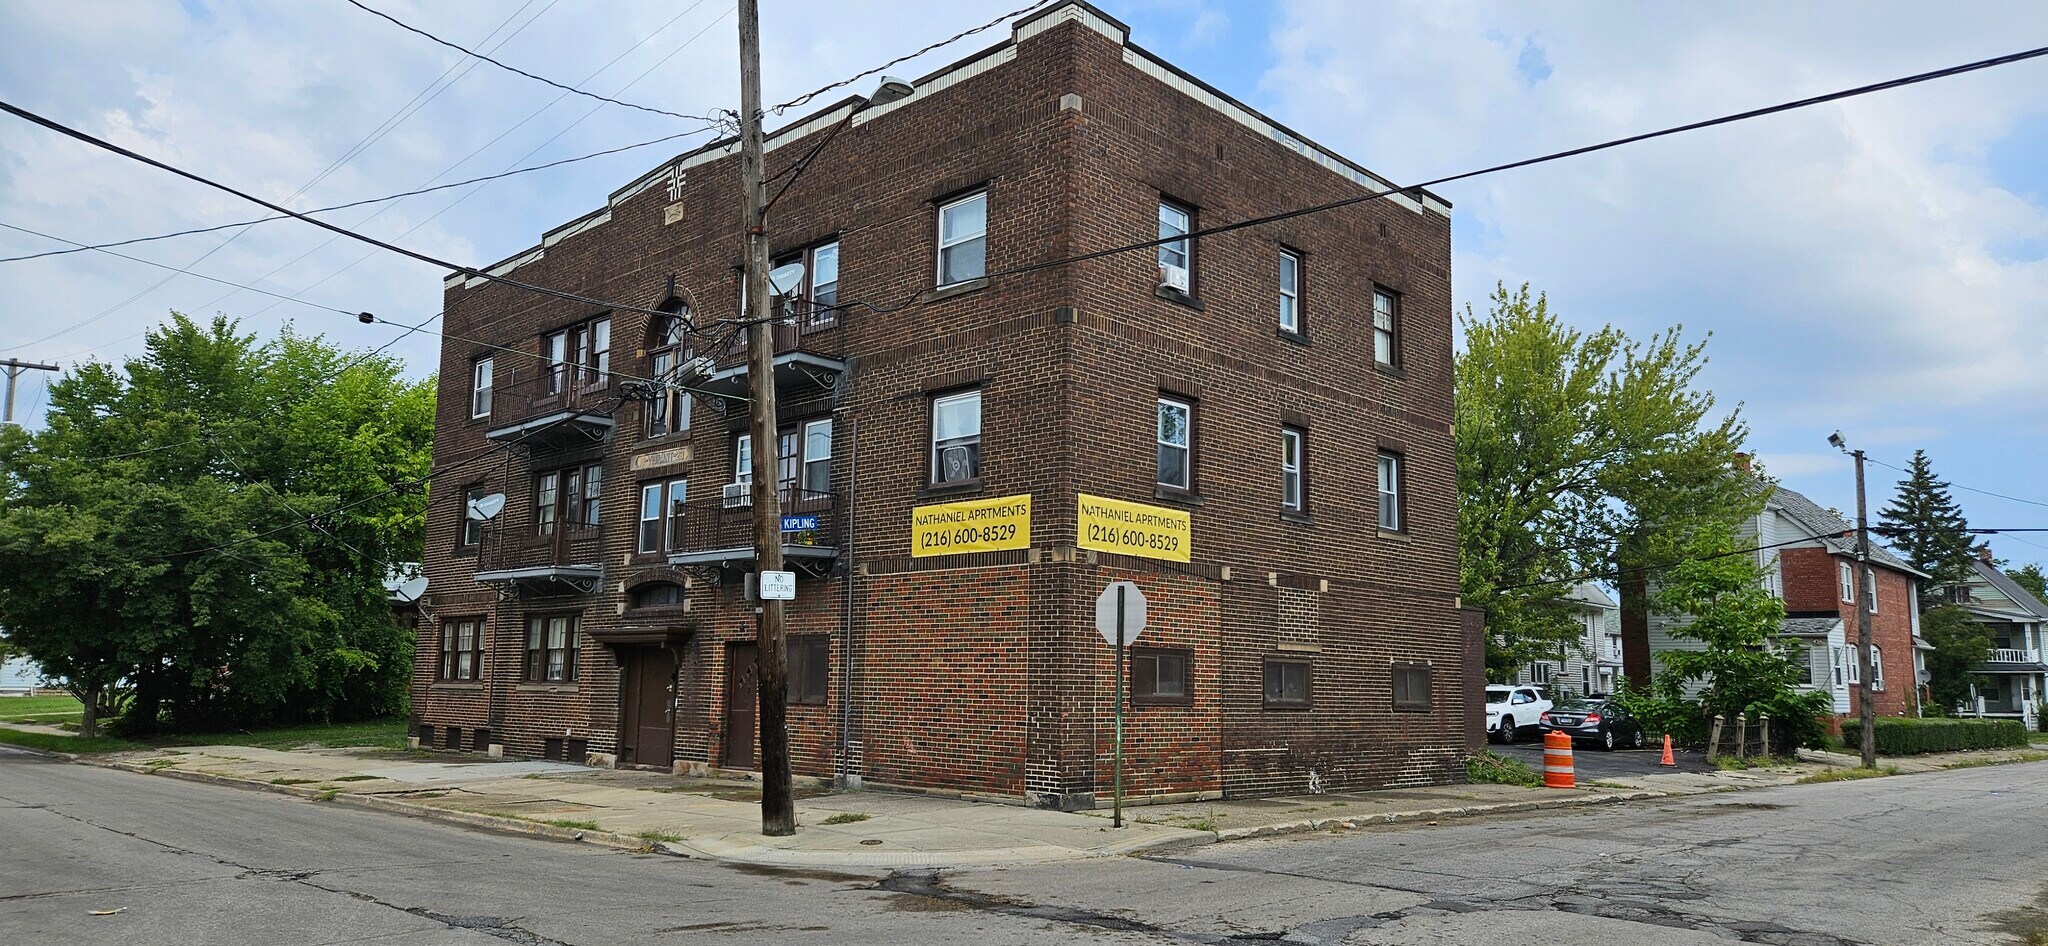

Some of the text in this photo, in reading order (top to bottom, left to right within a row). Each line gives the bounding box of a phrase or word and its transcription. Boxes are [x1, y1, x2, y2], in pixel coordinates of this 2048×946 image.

[784, 518, 815, 529] KIPLING
[915, 503, 1027, 527] NATHANIEL APRTMENTS
[1081, 503, 1187, 531] NATHANIEL APRTMENTS
[921, 524, 1016, 550] (216) 600-8529
[1087, 522, 1178, 552] (216) 600-8529
[764, 584, 793, 593] LITTERING
[774, 574, 784, 583] NO
